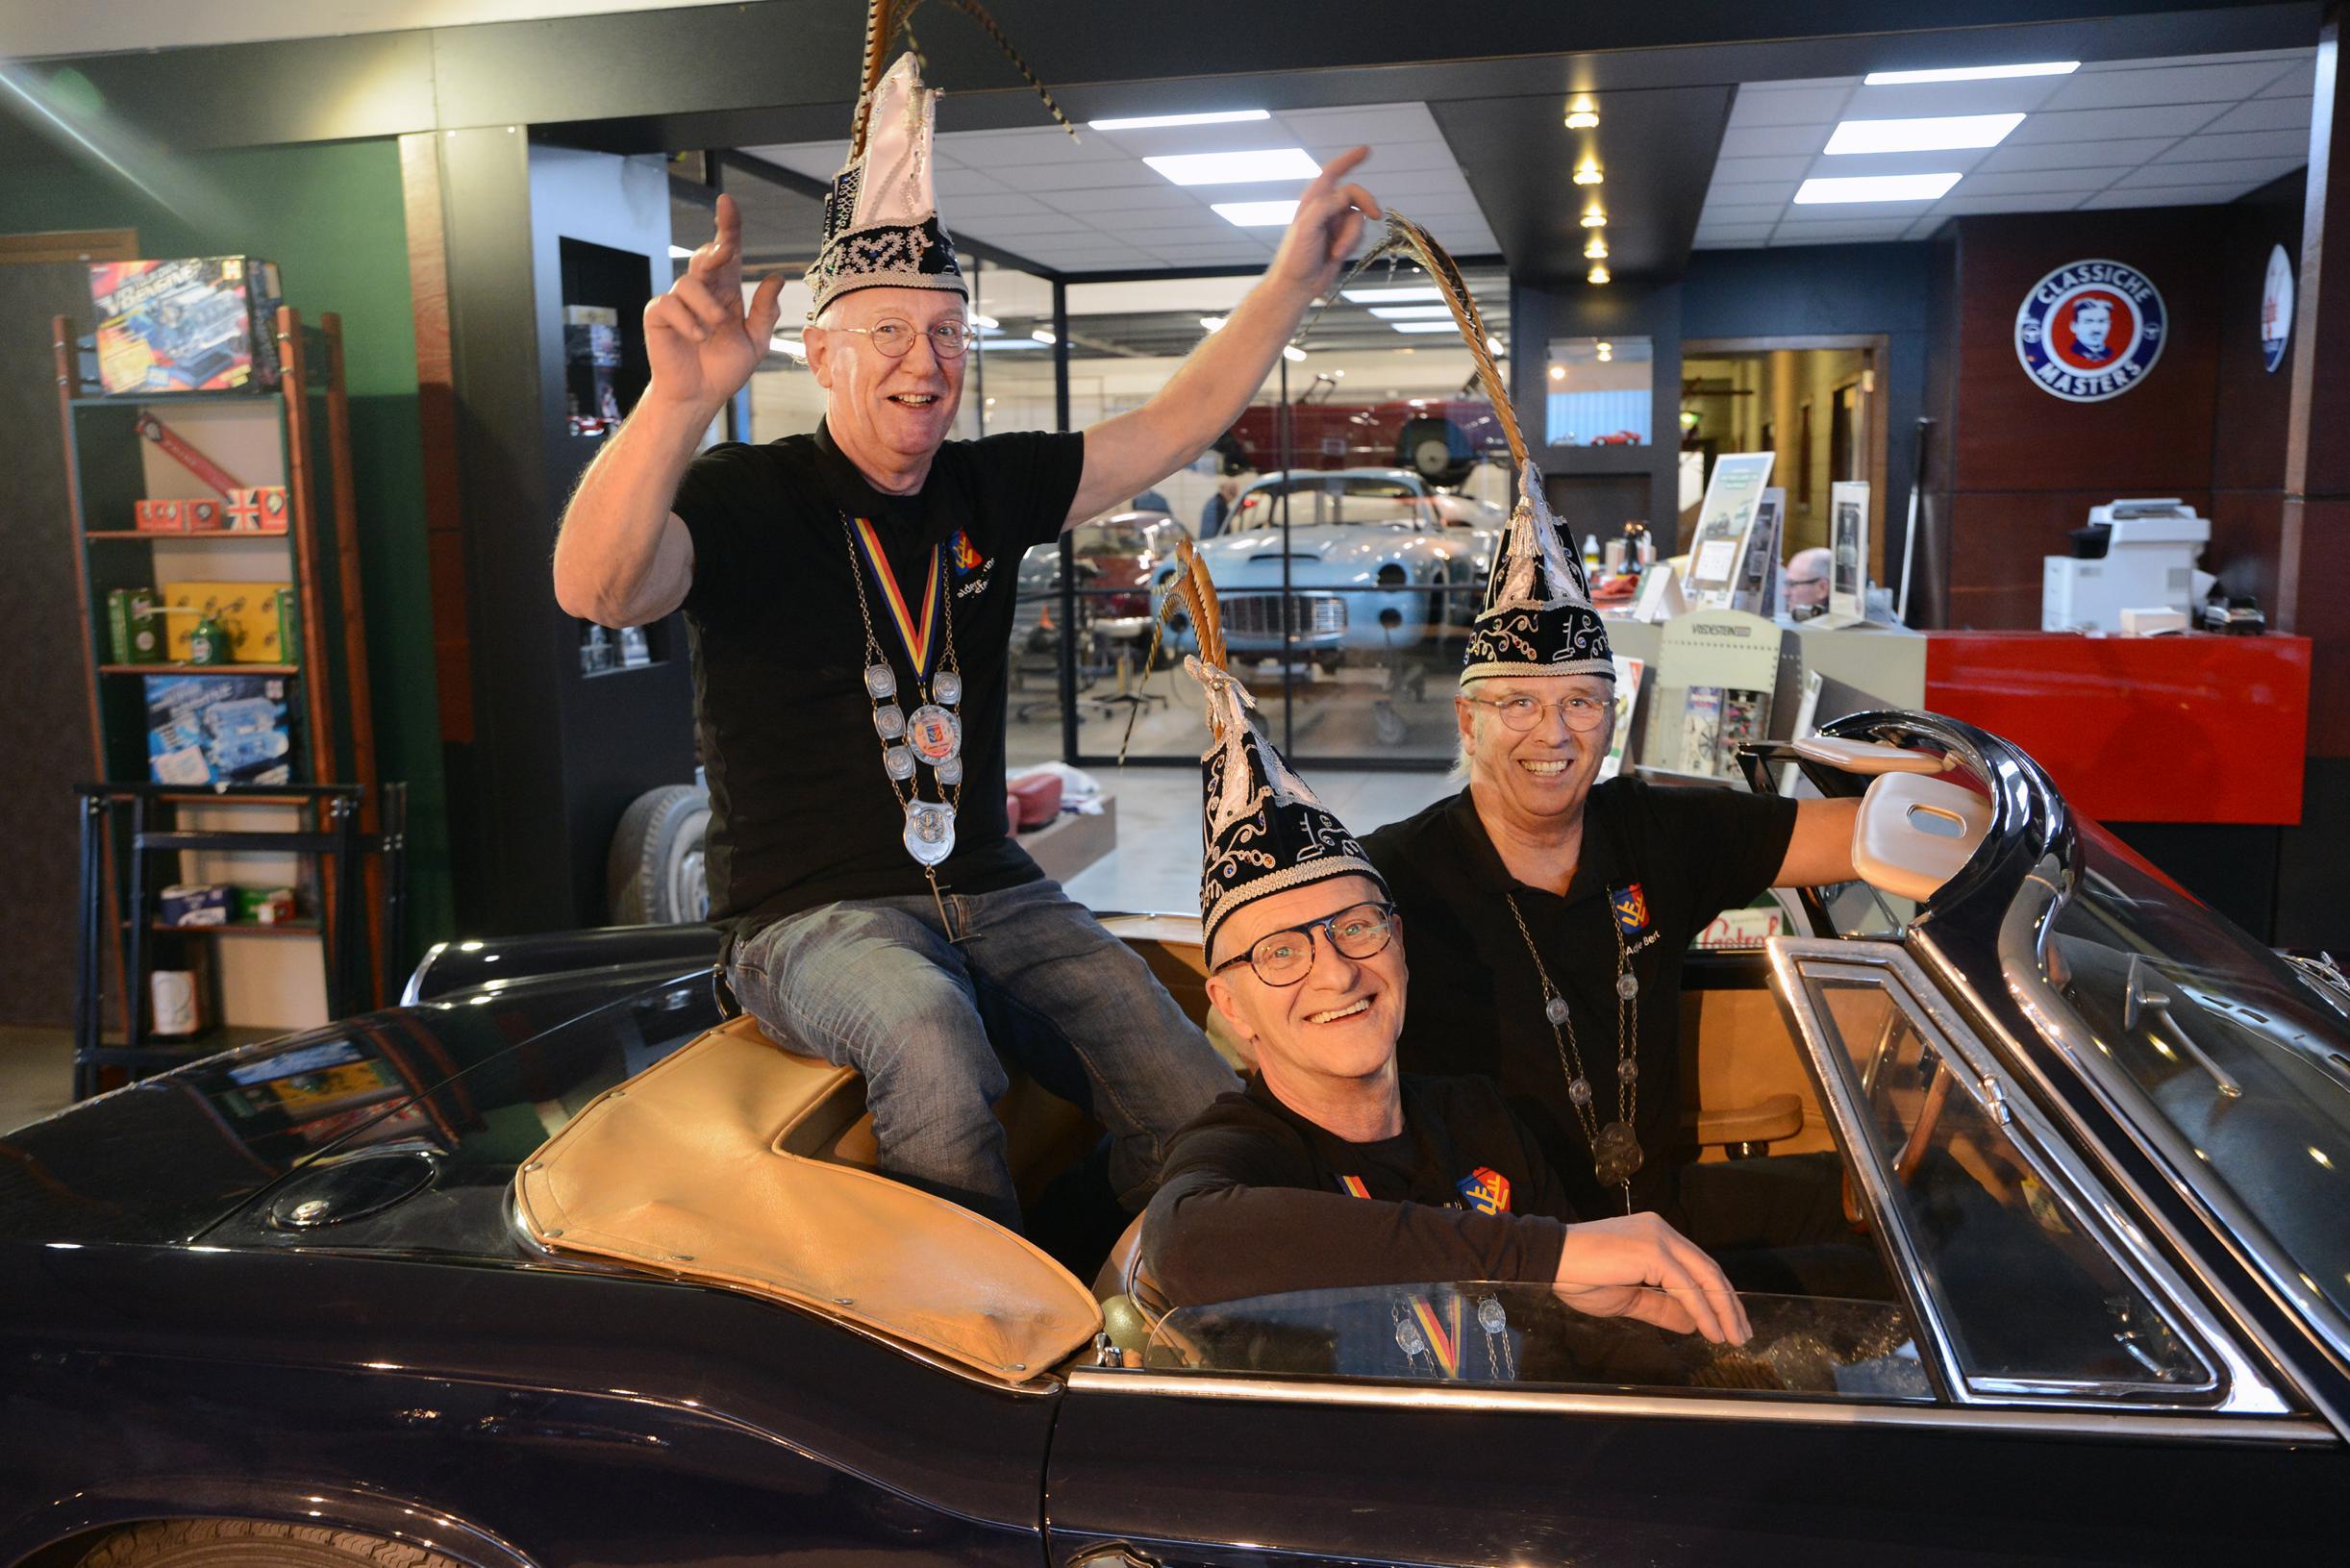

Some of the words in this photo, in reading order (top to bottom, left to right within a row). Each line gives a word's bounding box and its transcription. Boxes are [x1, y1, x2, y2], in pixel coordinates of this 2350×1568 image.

[2038, 264, 2154, 305] CLASSICHE
[2037, 361, 2142, 396] MASTERS
[1642, 930, 1661, 946] Bert
